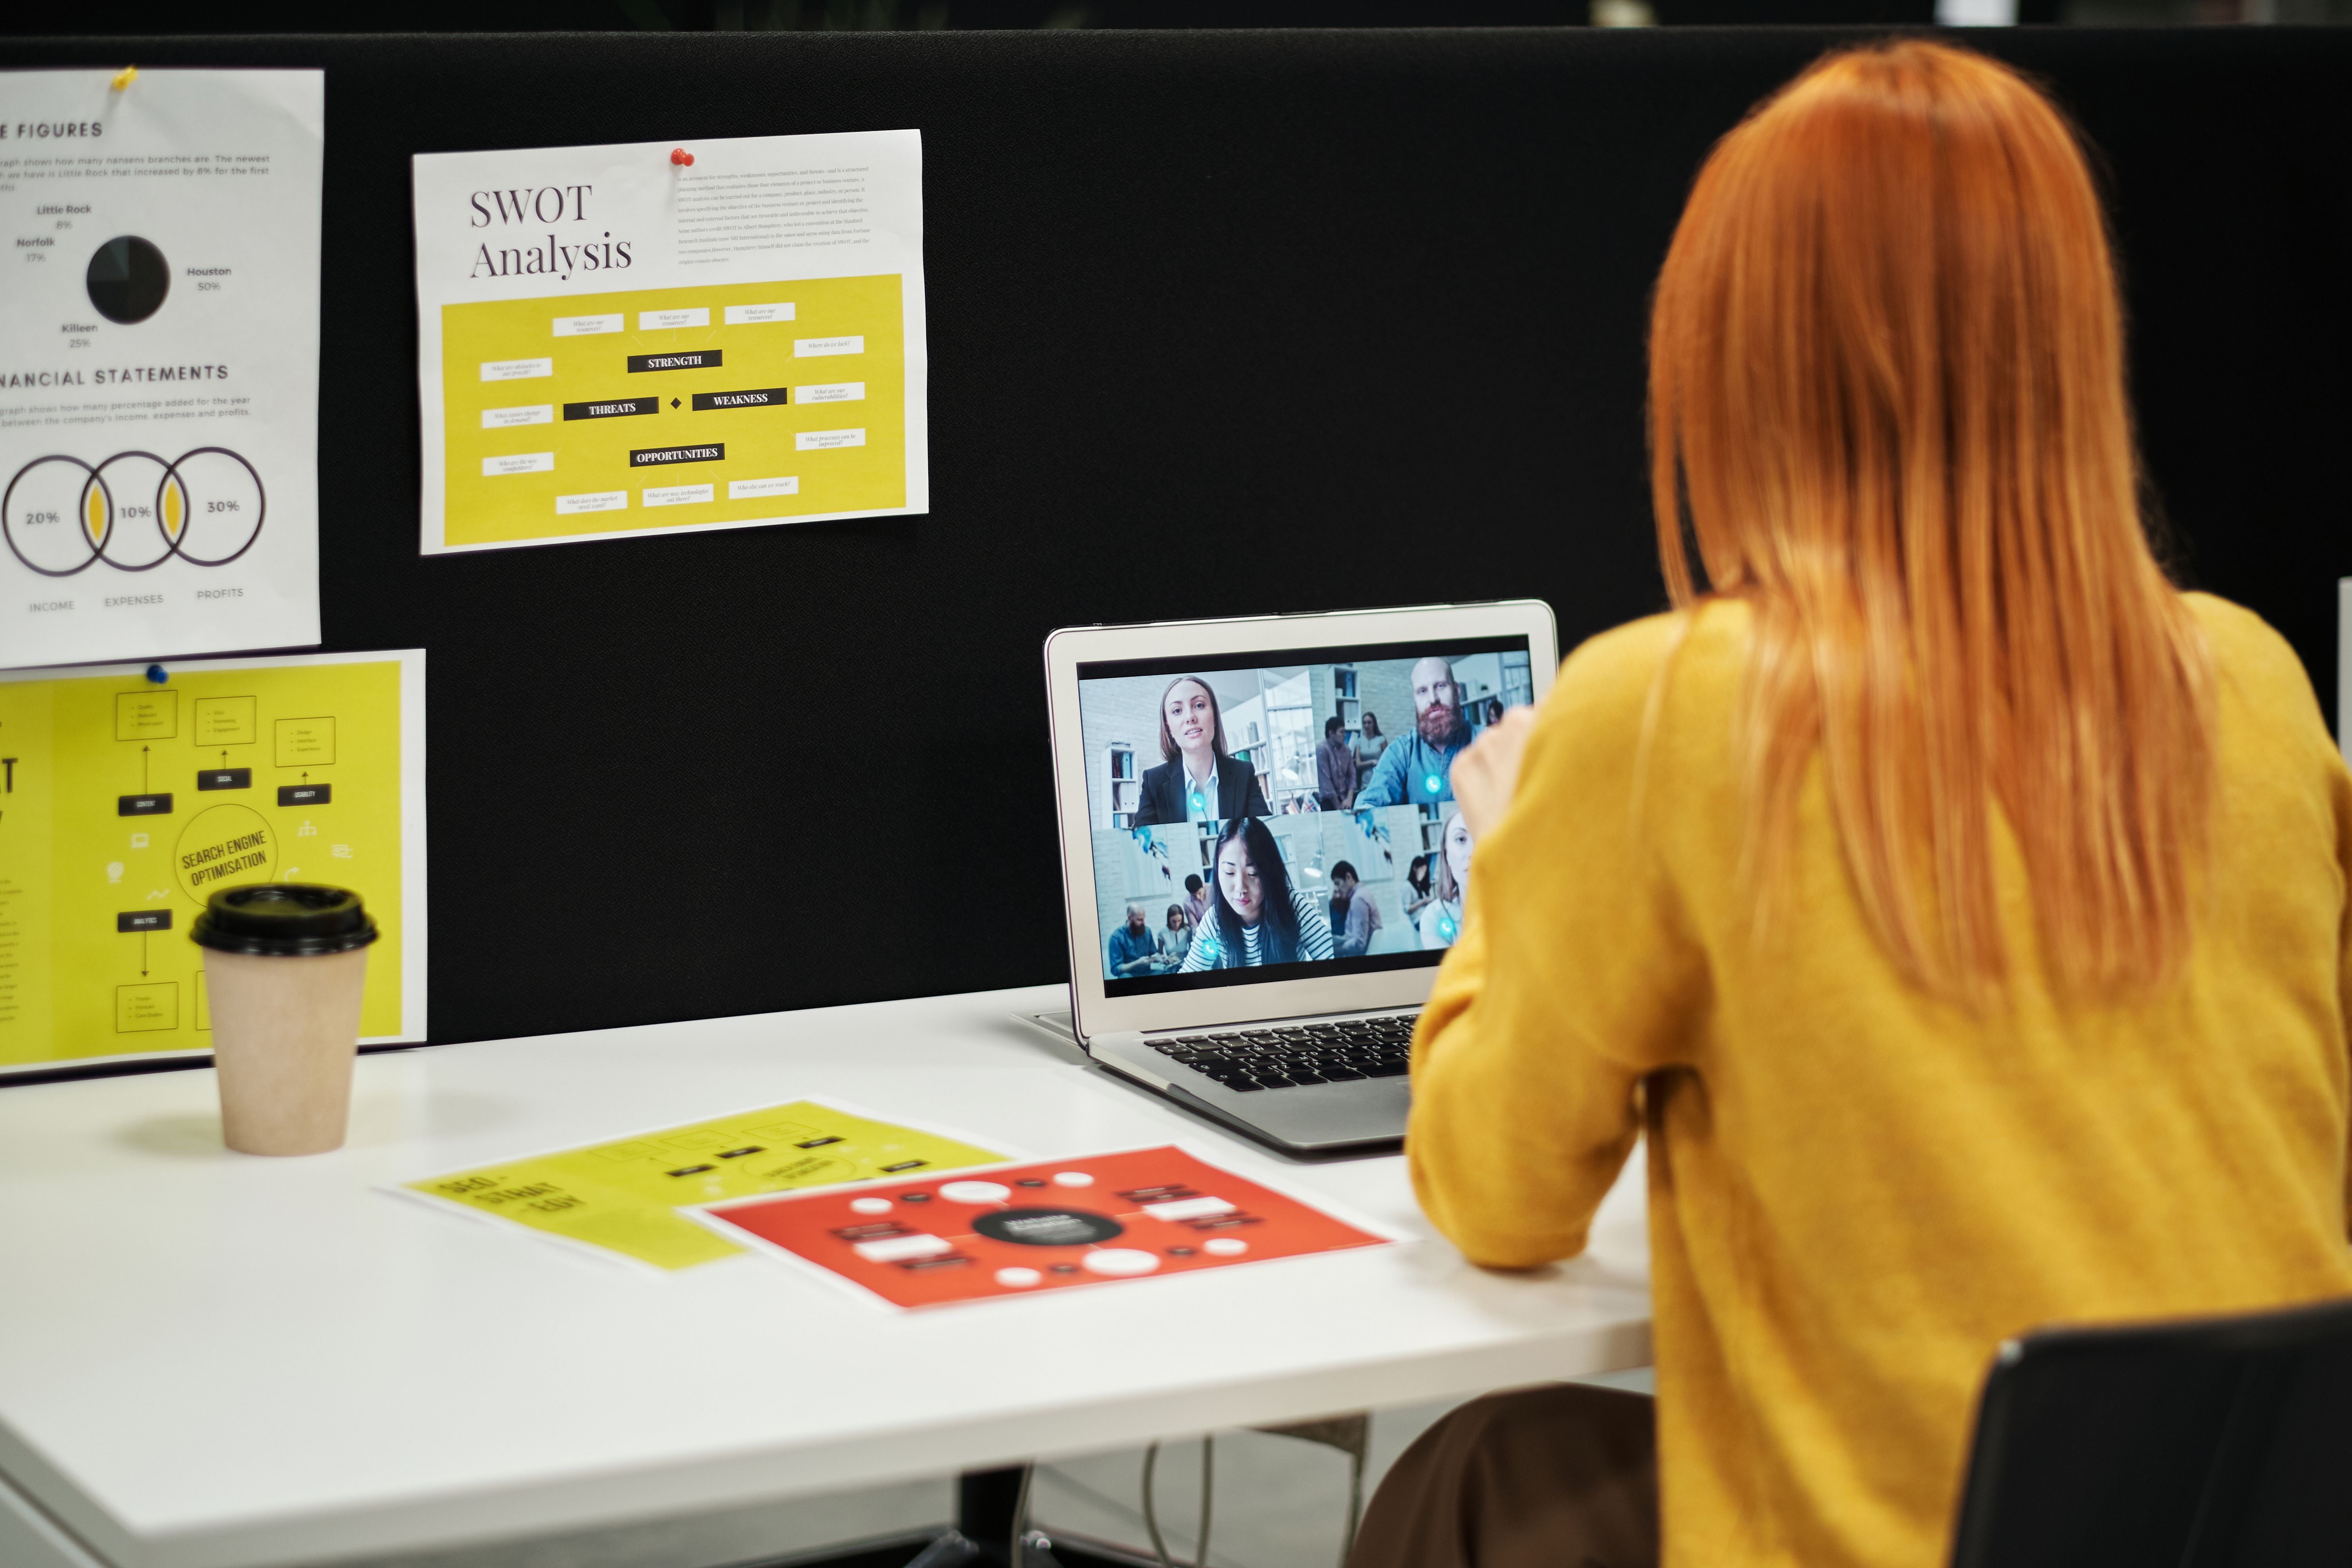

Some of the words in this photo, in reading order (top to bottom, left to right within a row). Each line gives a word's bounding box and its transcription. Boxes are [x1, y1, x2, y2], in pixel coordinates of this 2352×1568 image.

[0, 124, 7, 139] E
[18, 122, 102, 138] FIGURES
[0, 159, 20, 168] raph
[183, 167, 194, 176] by
[37, 205, 64, 214] Little
[65, 205, 91, 214] Rock
[470, 185, 592, 228] SWOT
[56, 221, 72, 229] 8%
[16, 238, 54, 247] Norfolk
[26, 253, 45, 262] 17%
[470, 232, 632, 280] Analysis
[186, 268, 231, 276] Houston
[197, 282, 221, 291] 50%
[61, 324, 98, 333] Killeen
[70, 339, 91, 348] 25%
[648, 356, 701, 368] STRENGTH
[0, 371, 85, 388] NANCIAL
[95, 365, 228, 384] STATEMENTS
[714, 394, 768, 405] WEAKNESS
[0, 407, 26, 416] graph
[112, 401, 162, 410] percentage
[164, 399, 194, 407] added
[590, 403, 635, 415] THREATS
[2, 419, 42, 427] between
[64, 416, 112, 425] company's
[116, 414, 151, 422] income,
[219, 408, 251, 417] profits.
[818, 440, 843, 449] improved?
[637, 448, 717, 463] OPPORTUNITIES
[681, 488, 708, 497] technologies
[208, 501, 239, 512] 30%
[26, 512, 59, 524] 20%
[121, 506, 151, 519] 10%
[197, 588, 243, 599] PROFITS
[30, 601, 75, 612] INCOME
[105, 595, 163, 607] EXPENSES
[0, 758, 18, 793] T
[183, 844, 226, 869] SEARCH
[227, 830, 267, 854] ENGINE
[191, 850, 267, 886] OPTIMISATION
